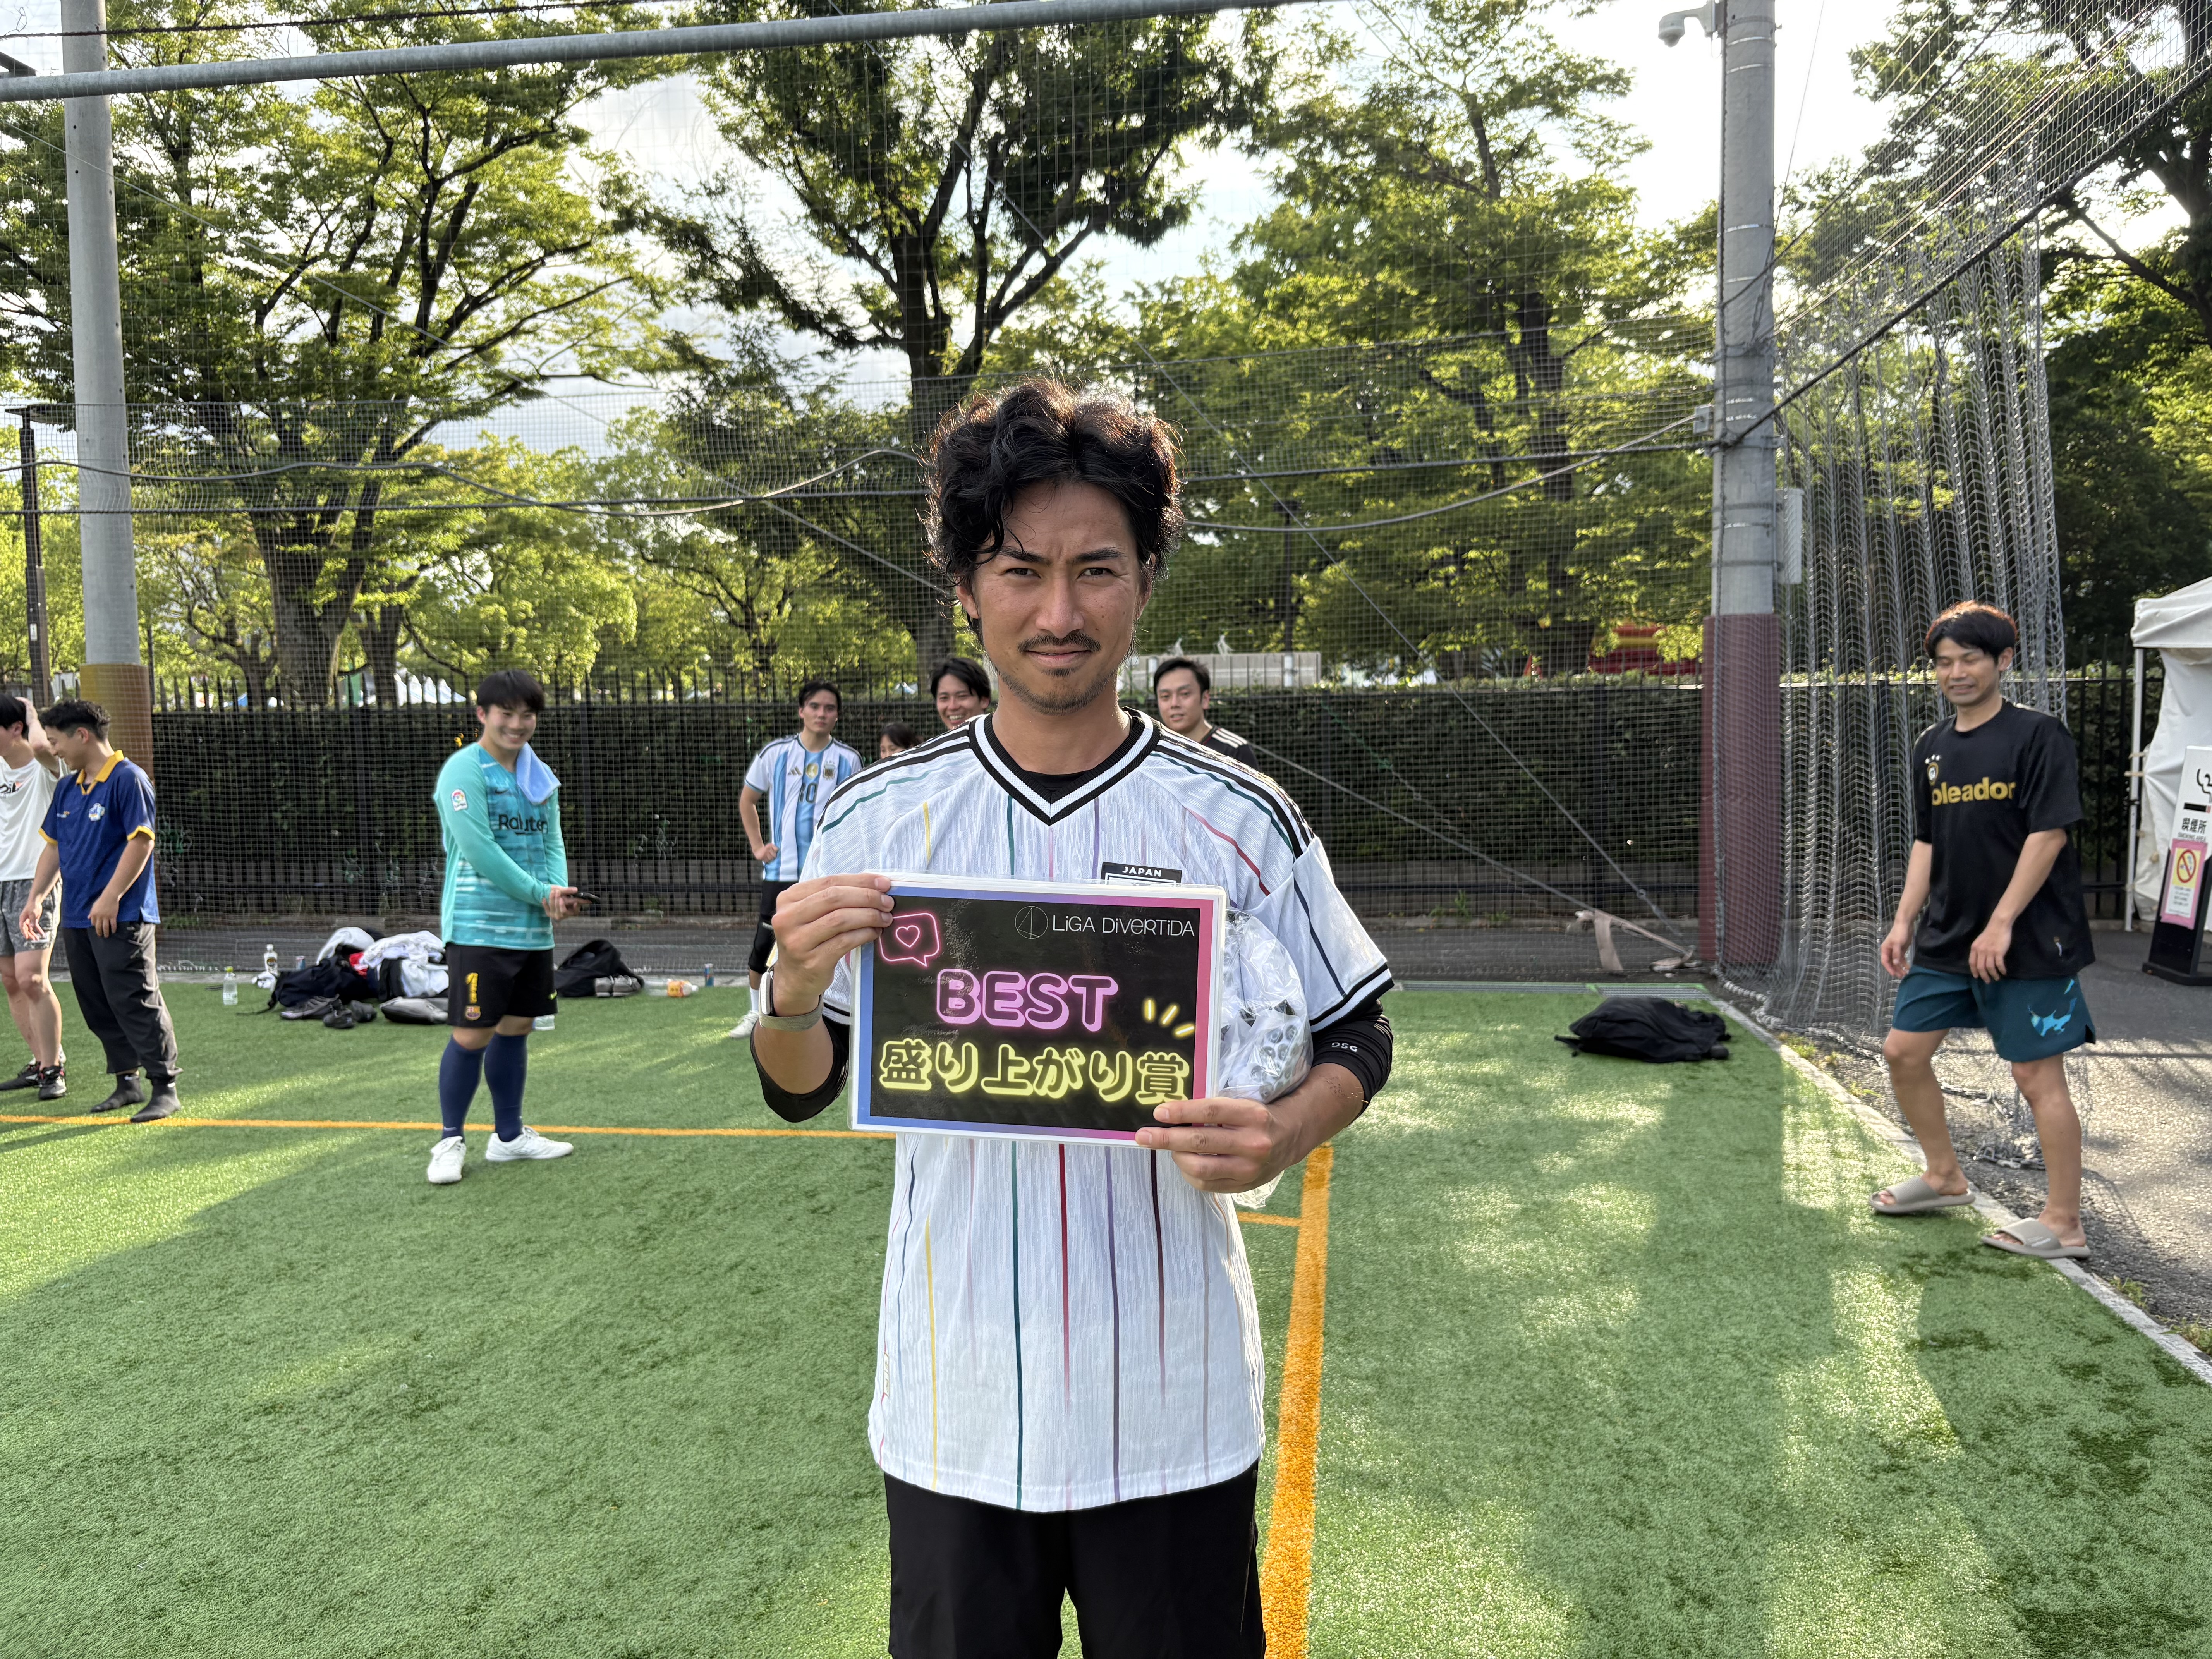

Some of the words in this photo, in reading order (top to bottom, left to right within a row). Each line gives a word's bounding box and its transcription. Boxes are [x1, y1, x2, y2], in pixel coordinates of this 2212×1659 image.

[799, 782, 819, 804] 10
[498, 814, 548, 834] Rauten
[1122, 866, 1162, 877] JAPAN
[466, 972, 479, 1004] 1
[936, 968, 1119, 1032] BEST
[879, 1037, 1190, 1105] 盛り上がり賞
